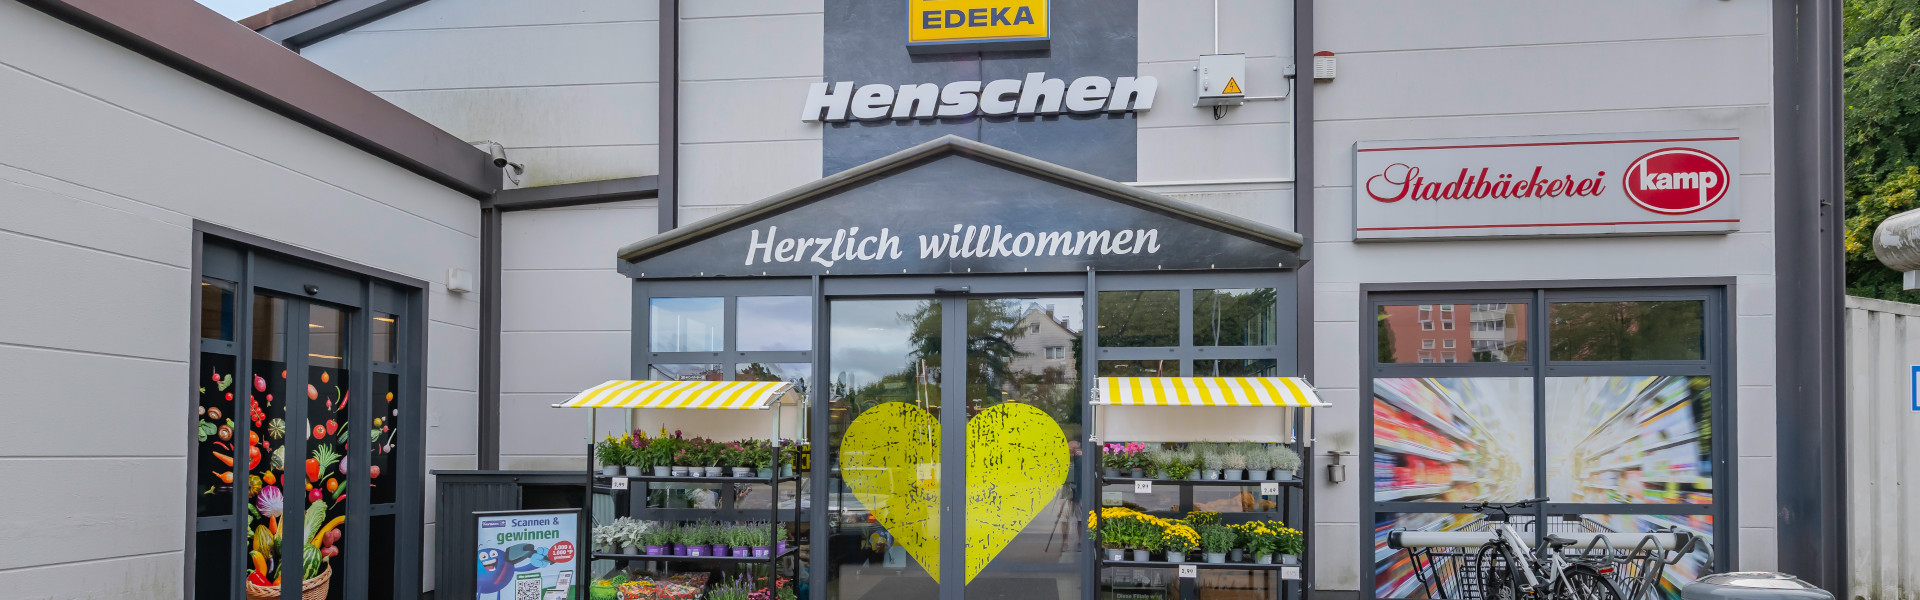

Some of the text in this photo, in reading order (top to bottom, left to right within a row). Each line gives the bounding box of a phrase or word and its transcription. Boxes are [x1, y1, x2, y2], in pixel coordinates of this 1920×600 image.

[922, 6, 1035, 29] EDEKA
[801, 72, 1158, 123] Henschen
[1366, 158, 1718, 206] Stadtbäckerei kamp
[745, 223, 1161, 267] Herzlich willkommen
[496, 529, 559, 545] gewinnen
[511, 517, 559, 527] Scannen &
